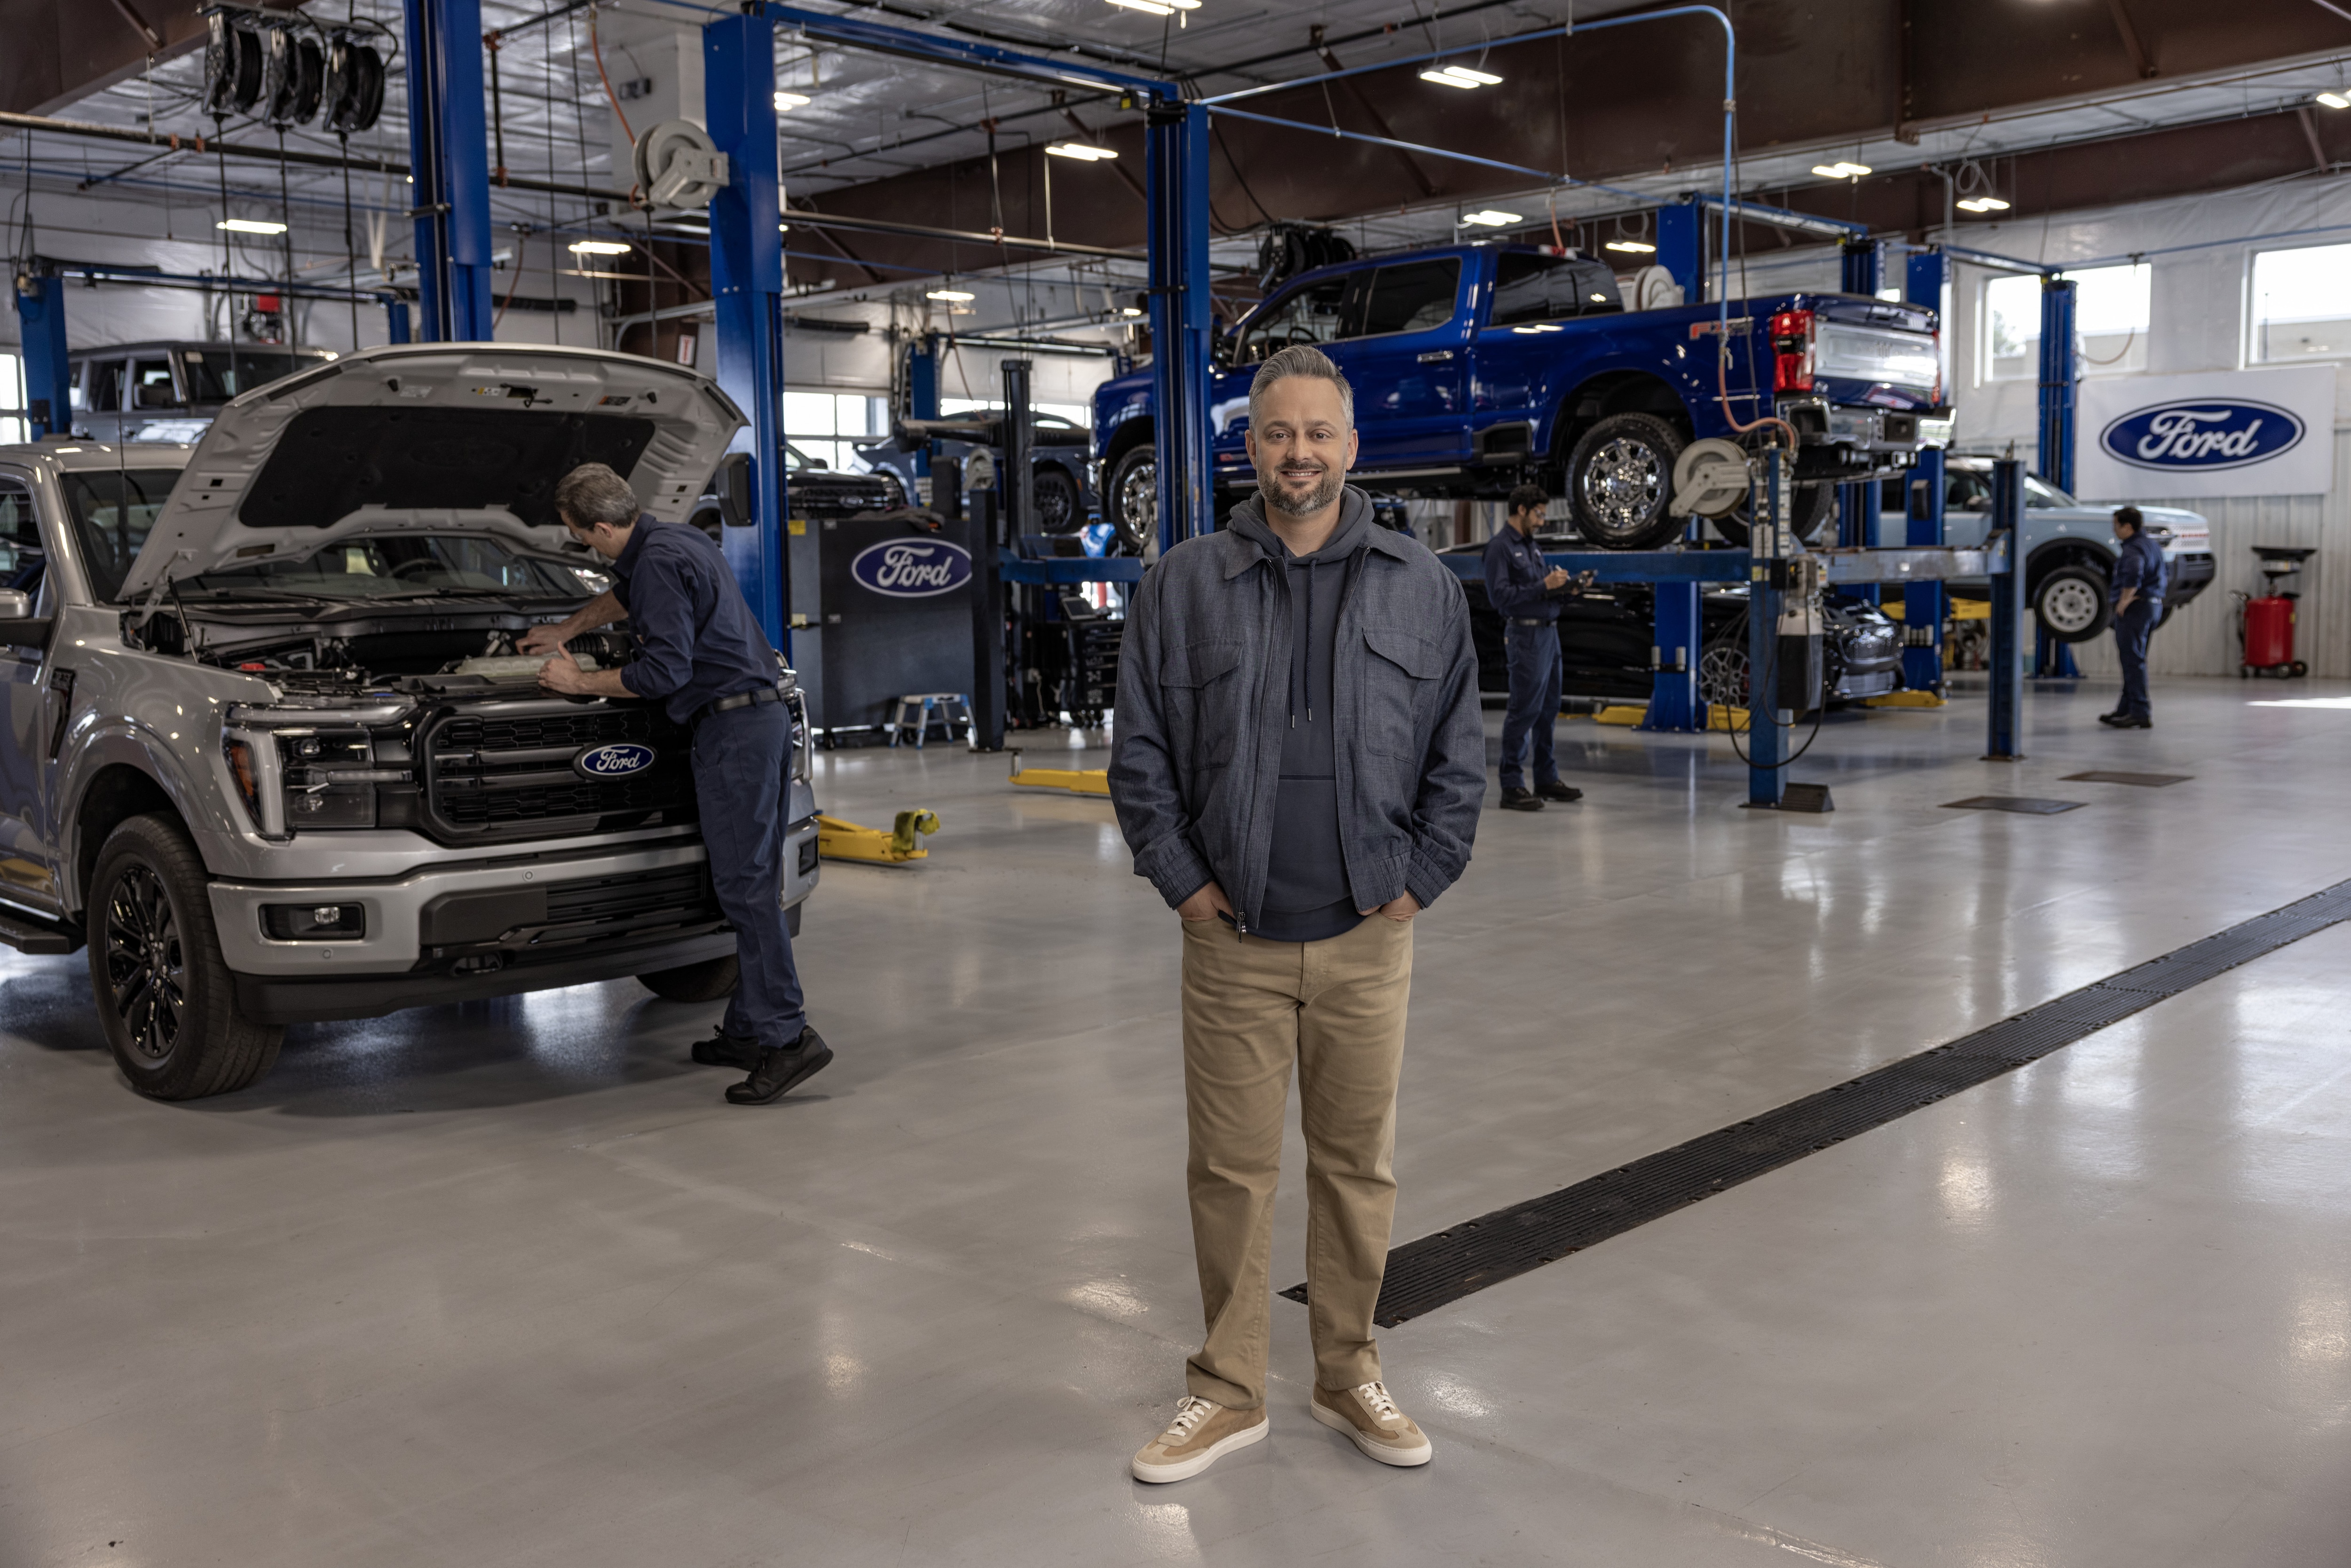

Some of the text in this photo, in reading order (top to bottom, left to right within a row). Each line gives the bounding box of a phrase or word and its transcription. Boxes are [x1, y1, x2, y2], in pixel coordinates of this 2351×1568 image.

[2137, 410, 2263, 459] Ford
[876, 545, 954, 587] Ford
[596, 749, 641, 771] Ford
